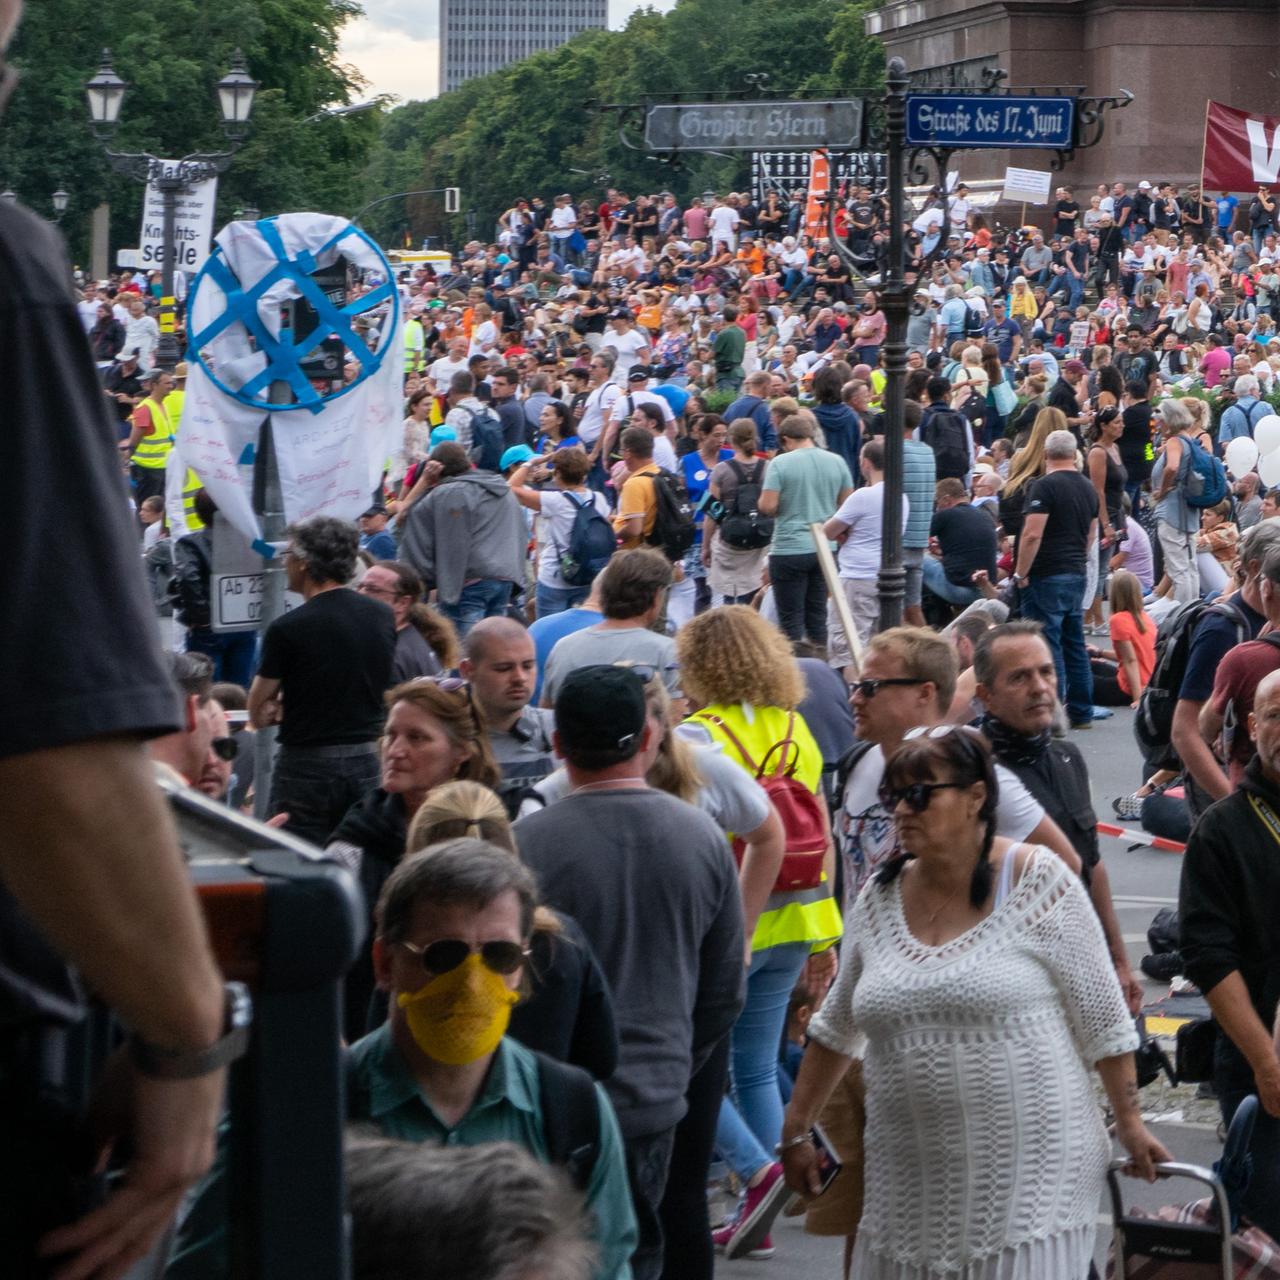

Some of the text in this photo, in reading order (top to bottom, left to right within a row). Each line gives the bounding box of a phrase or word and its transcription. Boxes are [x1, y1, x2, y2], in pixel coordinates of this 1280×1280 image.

[678, 108, 827, 140] Großer Stern
[918, 104, 1063, 139] Straße des 17. Juni
[144, 223, 200, 241] Knhts-
[142, 241, 197, 266] sele
[224, 579, 242, 596] Ab
